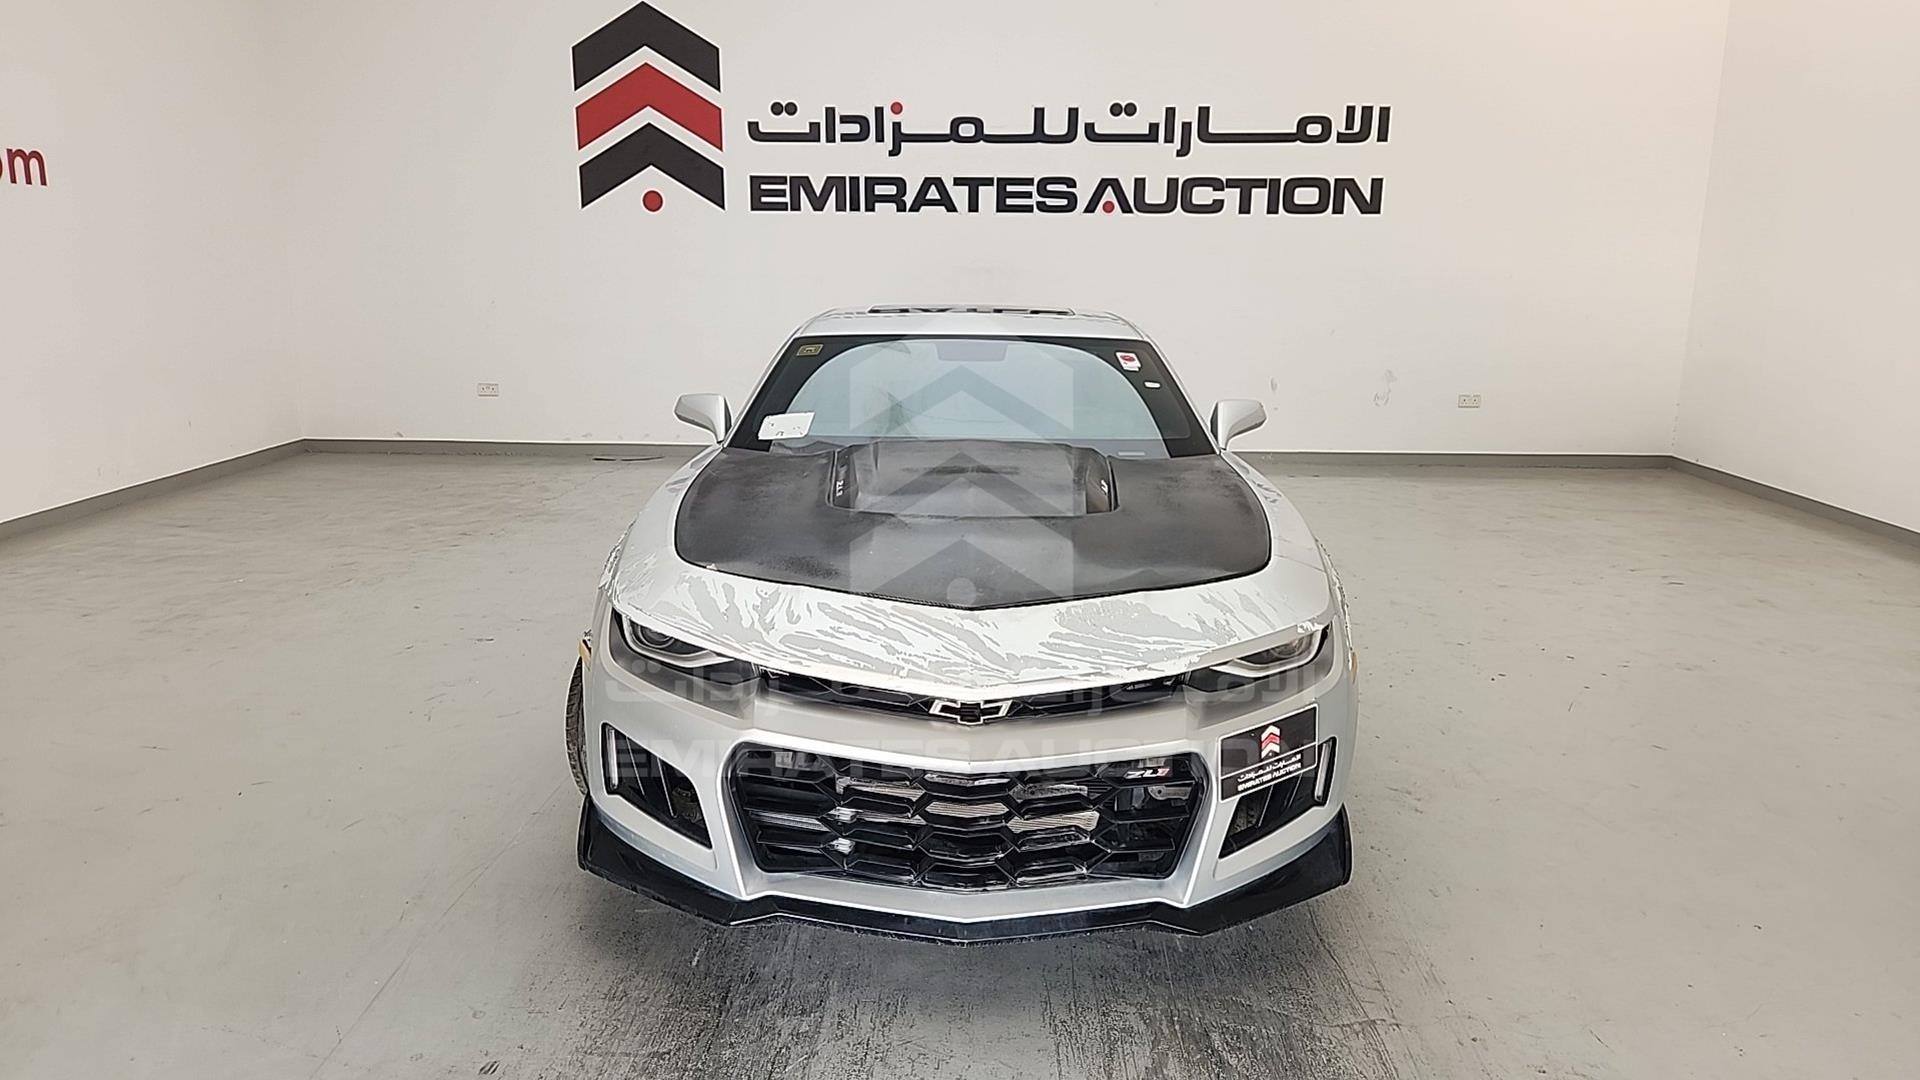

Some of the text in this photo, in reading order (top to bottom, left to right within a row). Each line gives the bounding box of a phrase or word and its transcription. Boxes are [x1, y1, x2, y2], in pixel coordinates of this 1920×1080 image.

[747, 101, 1079, 157] للمزادات
[750, 175, 1384, 215] EMIRATES AUCTION
